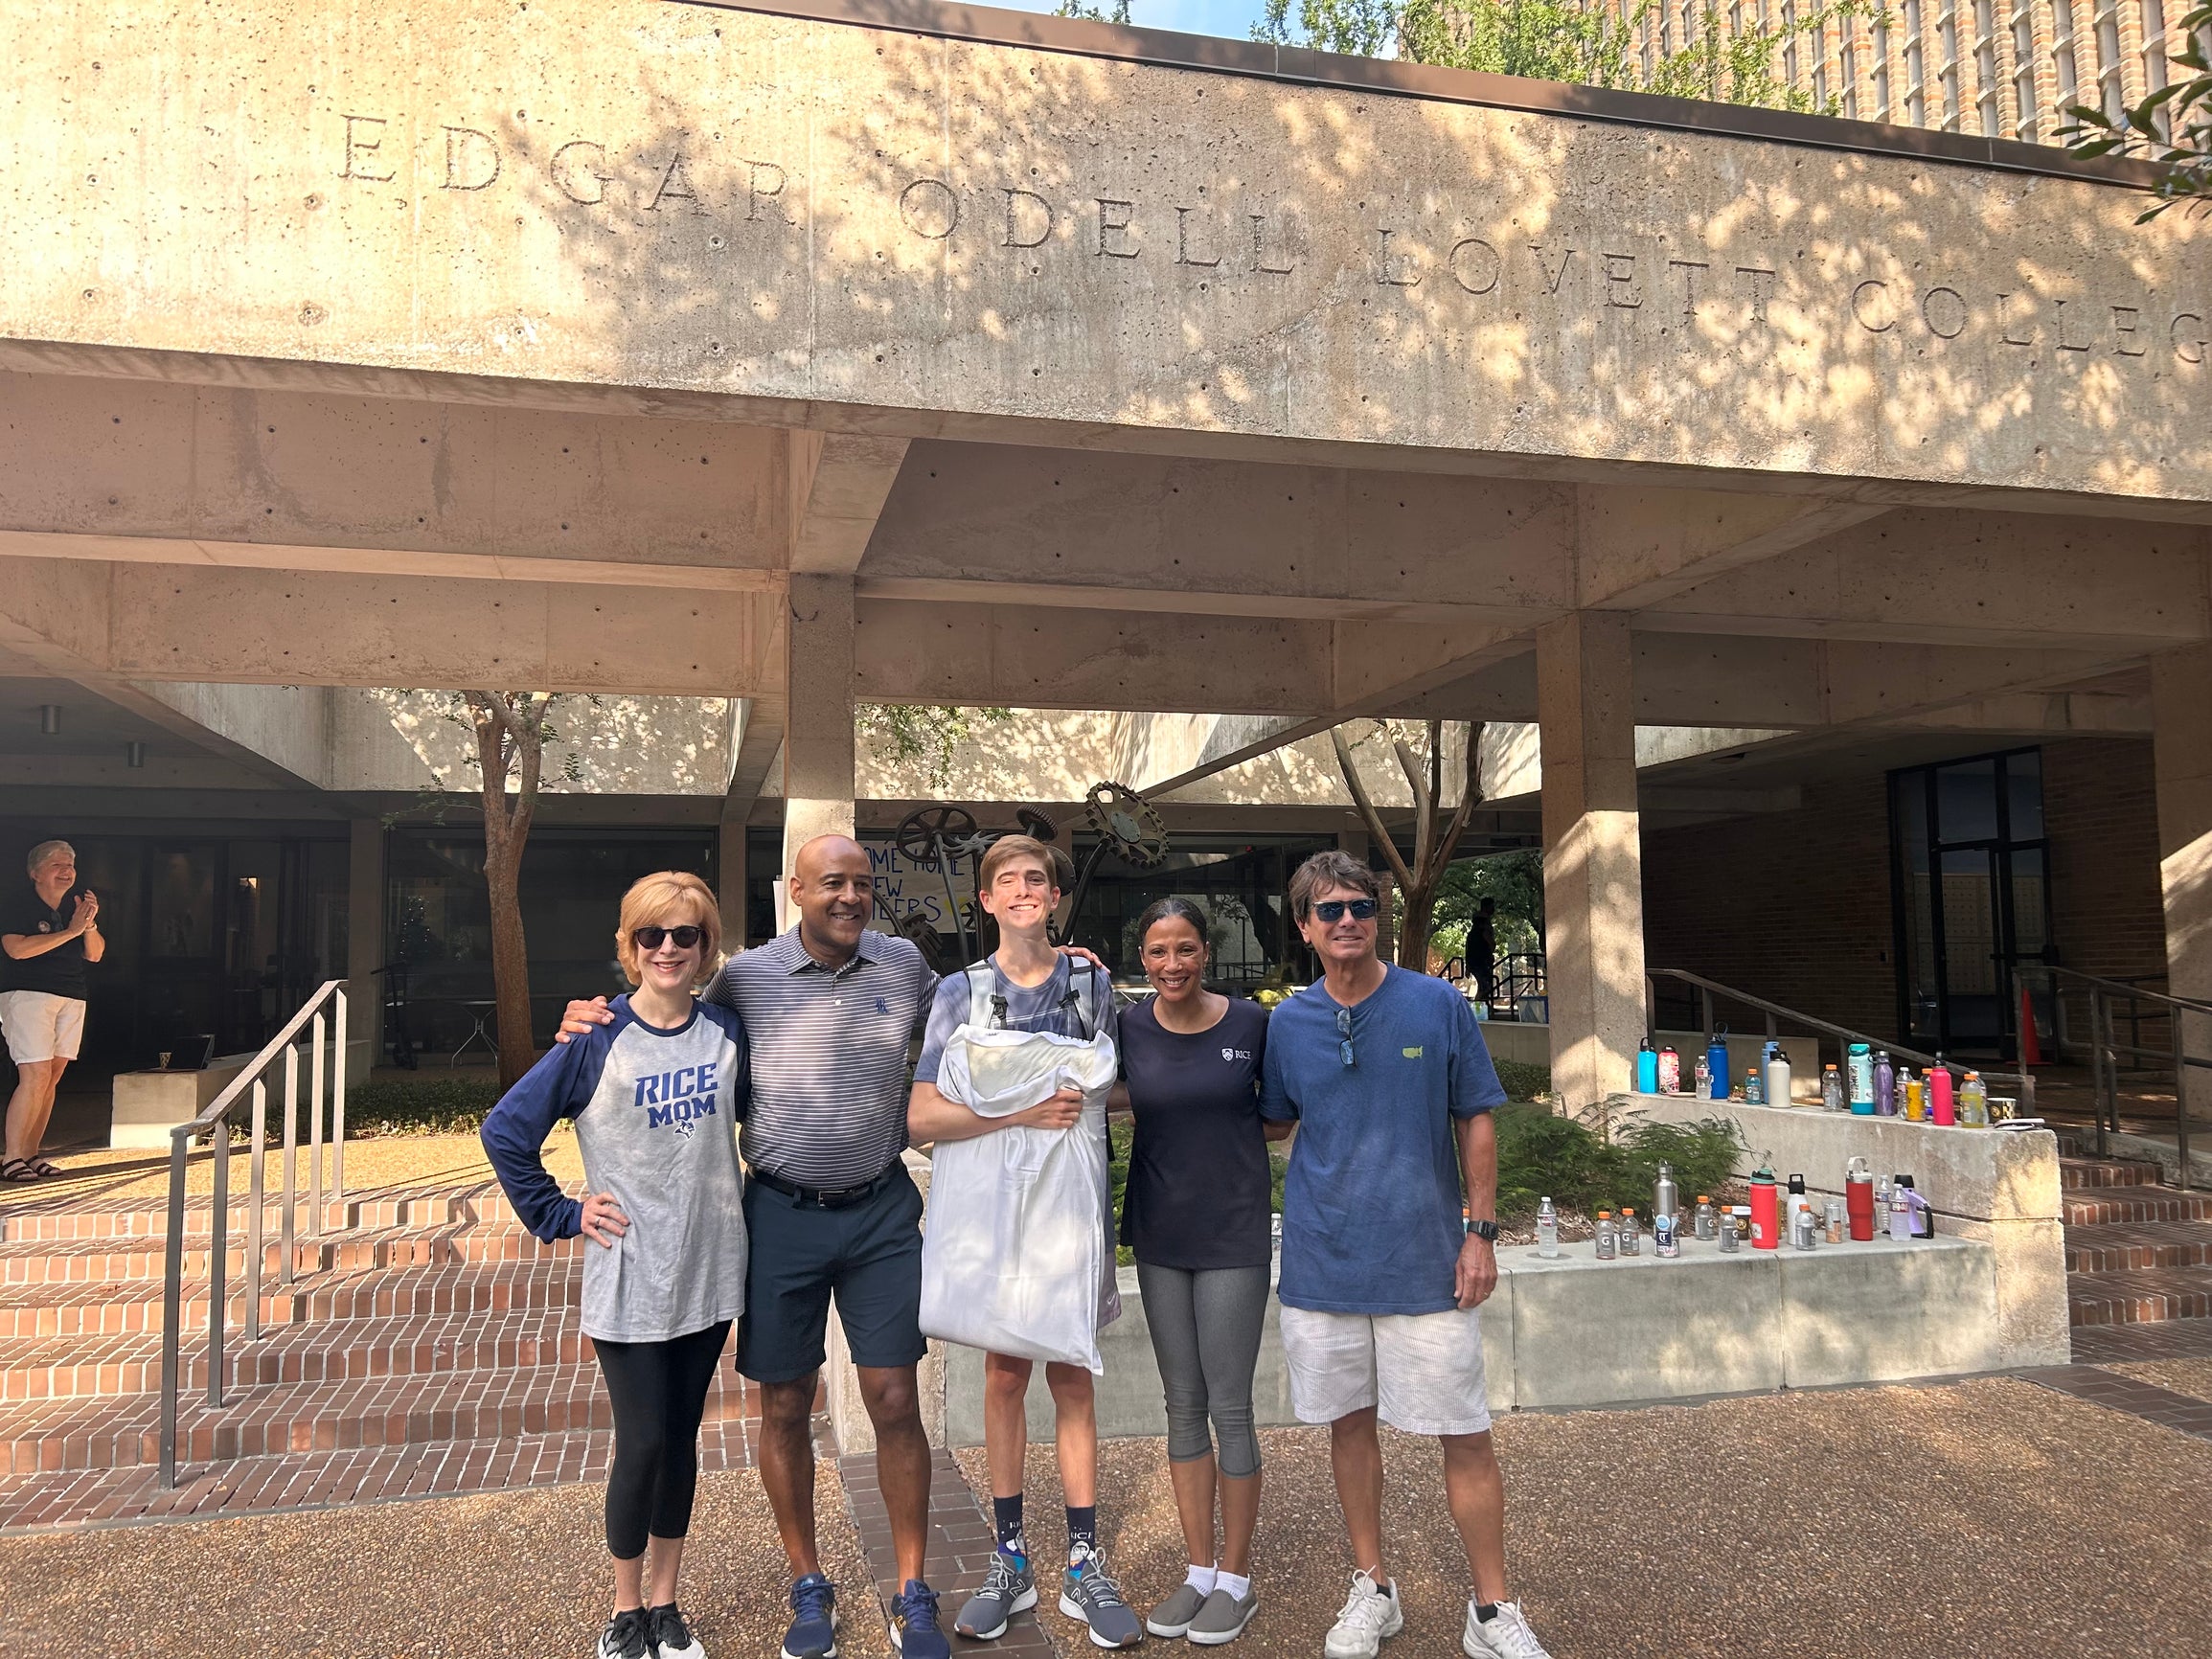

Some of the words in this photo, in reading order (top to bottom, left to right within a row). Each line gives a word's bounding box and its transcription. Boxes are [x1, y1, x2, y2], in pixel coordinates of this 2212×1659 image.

[337, 114, 797, 225] EDGAR
[899, 178, 1295, 276] ODELL
[1375, 229, 1776, 323] LOVETT
[872, 876, 902, 898] EW
[1235, 1050, 1251, 1059] RICE
[634, 1062, 718, 1107] RICE
[647, 1093, 717, 1129] MOM
[1601, 1237, 1610, 1246] G
[1622, 1233, 1630, 1242] G
